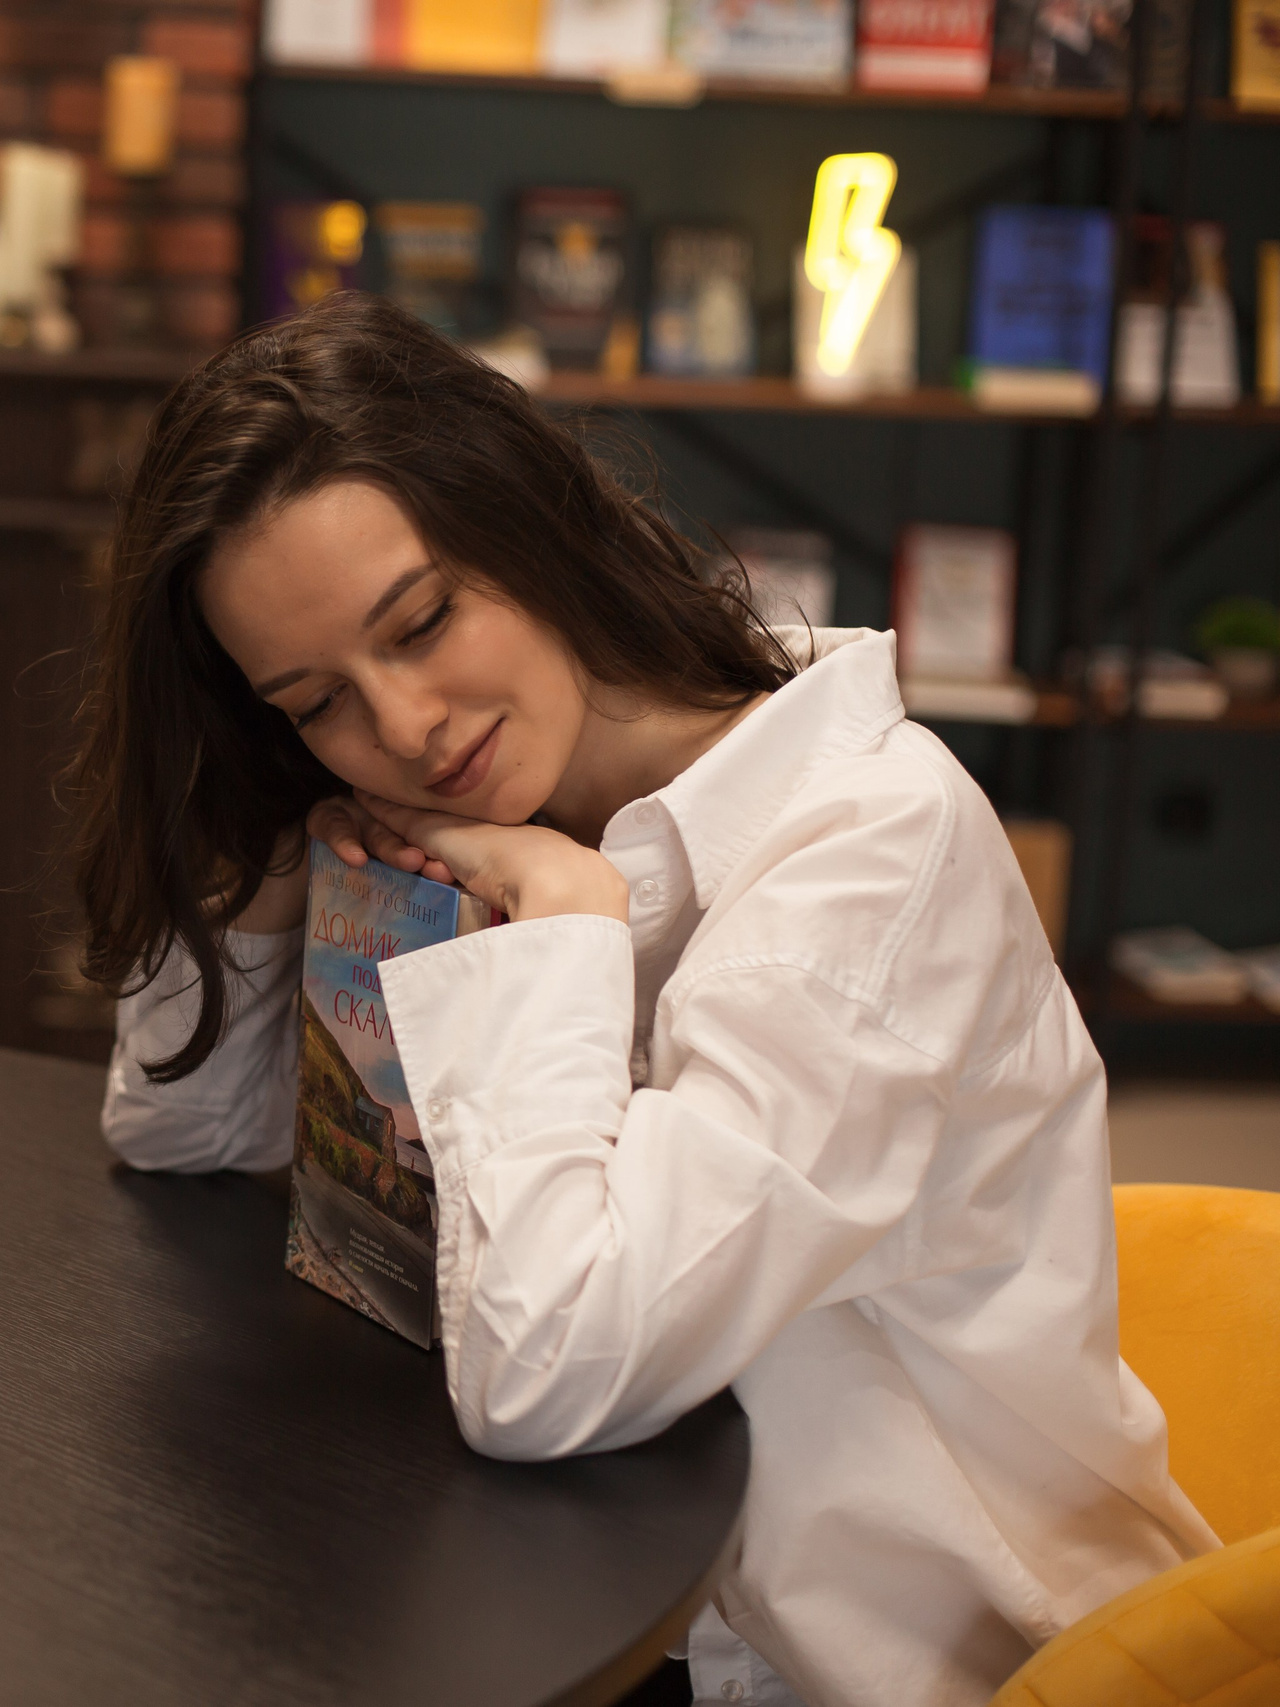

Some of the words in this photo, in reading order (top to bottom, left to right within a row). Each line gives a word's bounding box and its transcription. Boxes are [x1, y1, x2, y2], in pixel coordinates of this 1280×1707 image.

[377, 890, 440, 927] ГОСЛИНГ
[314, 907, 401, 961] ДОМИК
[353, 964, 382, 995] ПОД
